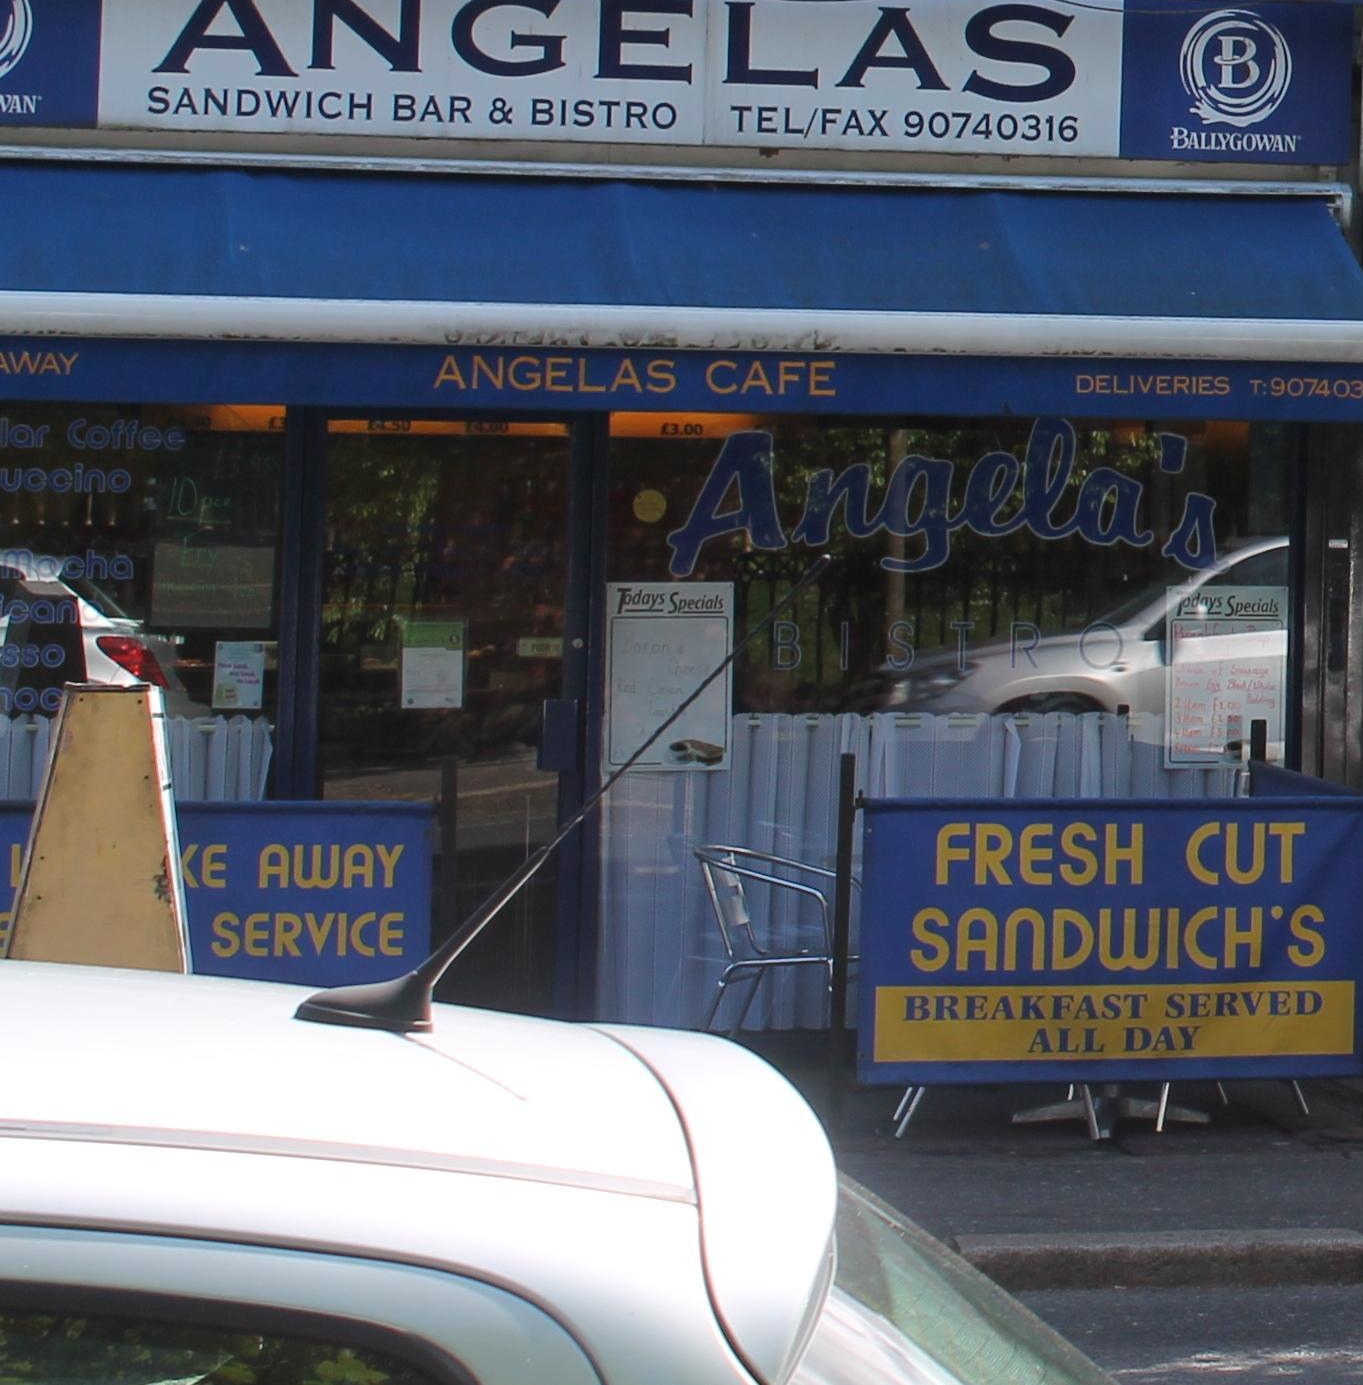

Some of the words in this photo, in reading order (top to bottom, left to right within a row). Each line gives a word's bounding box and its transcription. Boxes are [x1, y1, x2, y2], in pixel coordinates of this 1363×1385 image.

[147, 86, 374, 121] SANDWICH
[392, 94, 472, 125] BAR
[488, 97, 514, 126] &
[530, 98, 678, 131] BISTRO
[730, 104, 890, 139] TEL/FAX
[903, 111, 1080, 143] 90740316
[1170, 126, 1297, 153] BALLYGOWAN
[433, 353, 678, 394] ANGELAS
[705, 359, 837, 396] CAFE
[1075, 374, 1231, 396] DELIVERIES
[66, 417, 188, 452] Coffee
[660, 423, 705, 438] £3.00
[668, 417, 1217, 578] Angela's
[617, 587, 666, 615] Todays
[667, 591, 725, 615] Specials
[1224, 595, 1280, 617] Specials
[773, 620, 1124, 671] BISTRO
[258, 843, 405, 889] AWAY
[935, 822, 1143, 886] FRESH
[1186, 822, 1306, 885] CUT
[211, 911, 405, 958] SERVICE
[909, 904, 1327, 973] SANDWICH'S
[903, 992, 1149, 1023] BREAKFAST
[1163, 989, 1323, 1019] SERVED
[1027, 1025, 1106, 1054] ALL
[1122, 1024, 1201, 1053] DAY
